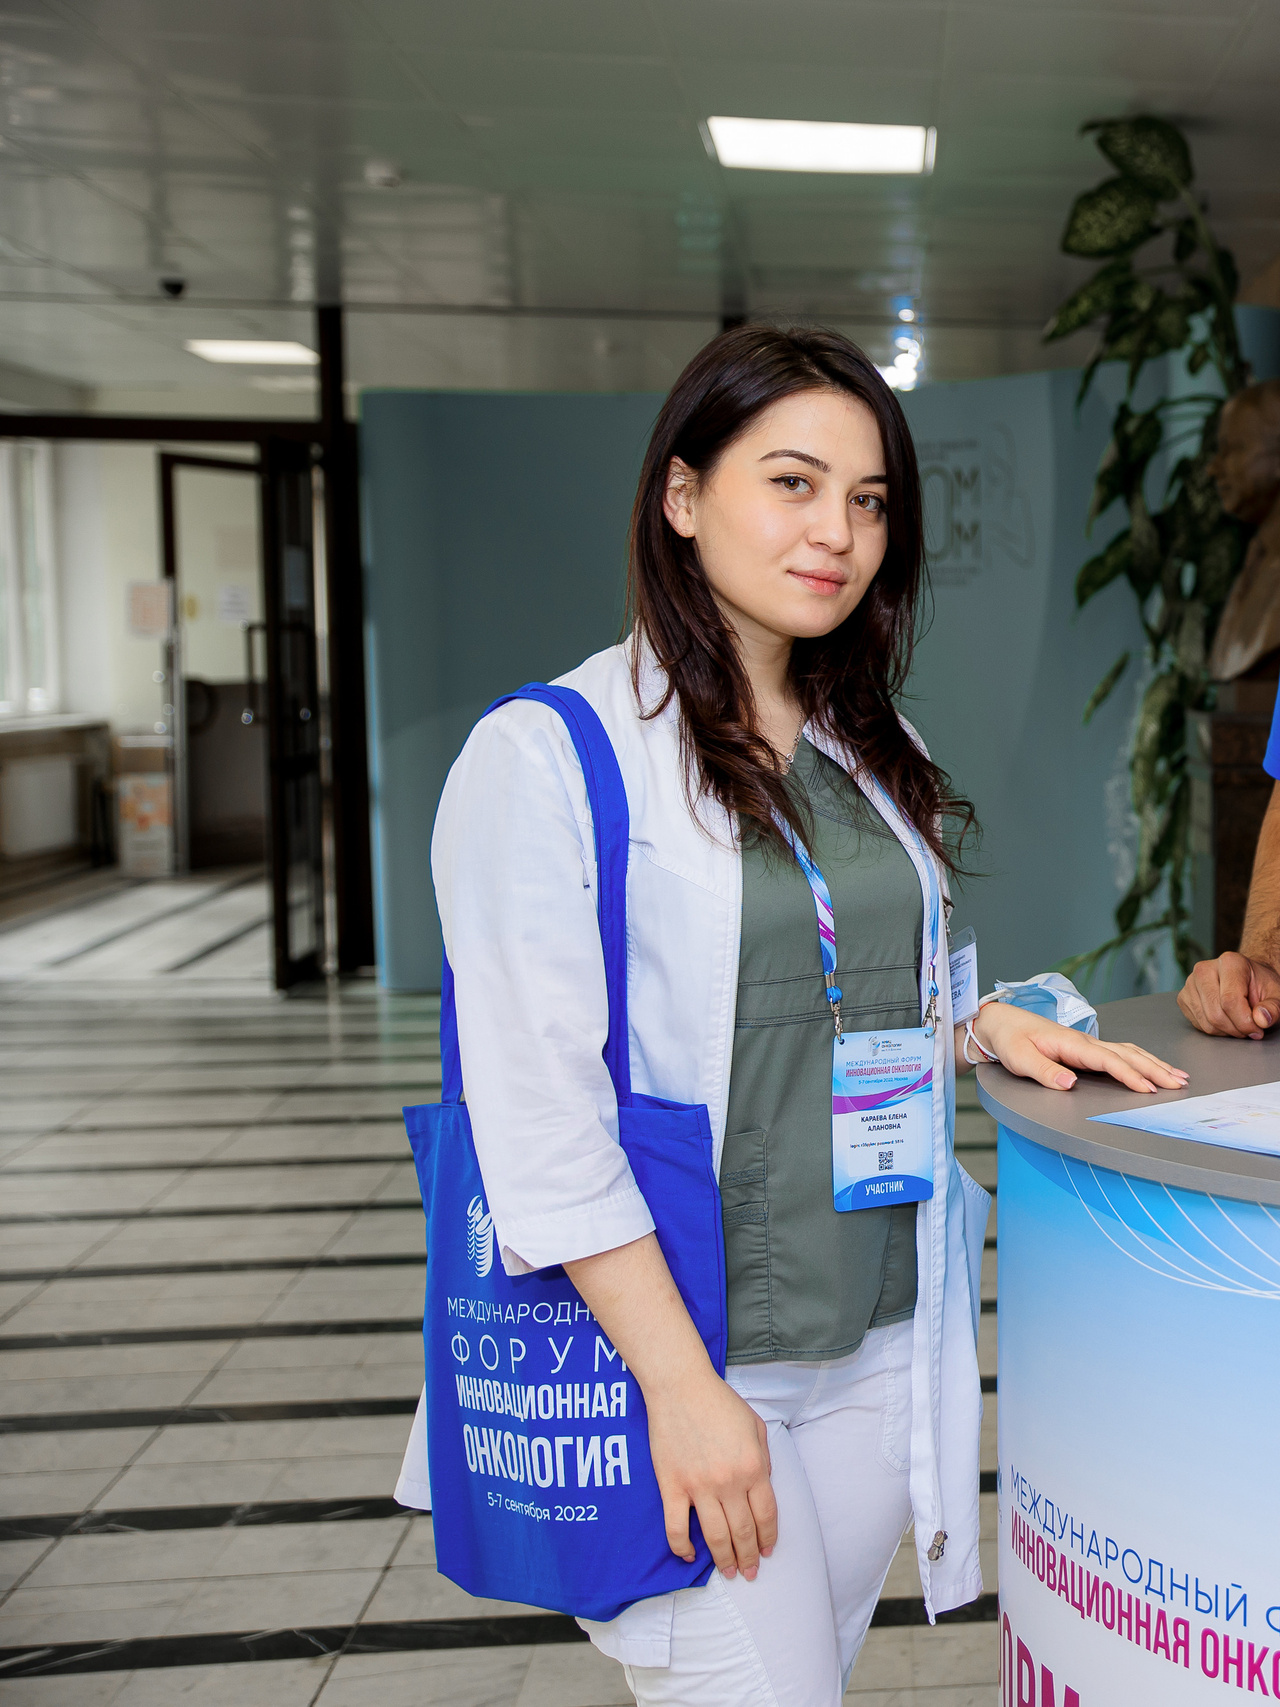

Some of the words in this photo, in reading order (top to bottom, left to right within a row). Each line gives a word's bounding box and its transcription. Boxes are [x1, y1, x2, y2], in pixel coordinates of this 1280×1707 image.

[845, 1057, 899, 1067] МЕЖДУНАРОДНЫЙ
[901, 1055, 922, 1063] ФОРУМ
[845, 1066, 891, 1078] ИННОВАЦИОННАЯ
[891, 1063, 922, 1074] ОНКОЛОГИЯ
[861, 1114, 887, 1123] КАРАЕВА
[888, 1112, 908, 1120] ЕЛЕНА
[867, 1123, 901, 1132] АЛАНОВНА
[865, 1180, 905, 1196] УЧАСТНИК
[447, 1296, 600, 1326] МЕЖДУНАРОДН
[450, 1331, 627, 1374] ФОРУМ
[455, 1374, 627, 1422] ИННОВАЦИОННАЯ
[462, 1423, 631, 1488] ОНКОЛОГИЯ
[487, 1491, 503, 1508] 5-7
[504, 1497, 550, 1523] сентября
[554, 1505, 599, 1522] 2022
[1010, 1464, 1248, 1627] МЕЖДУНАРОДНЫЙ
[1010, 1504, 1191, 1670] ИННОВАЦИОННАЯ
